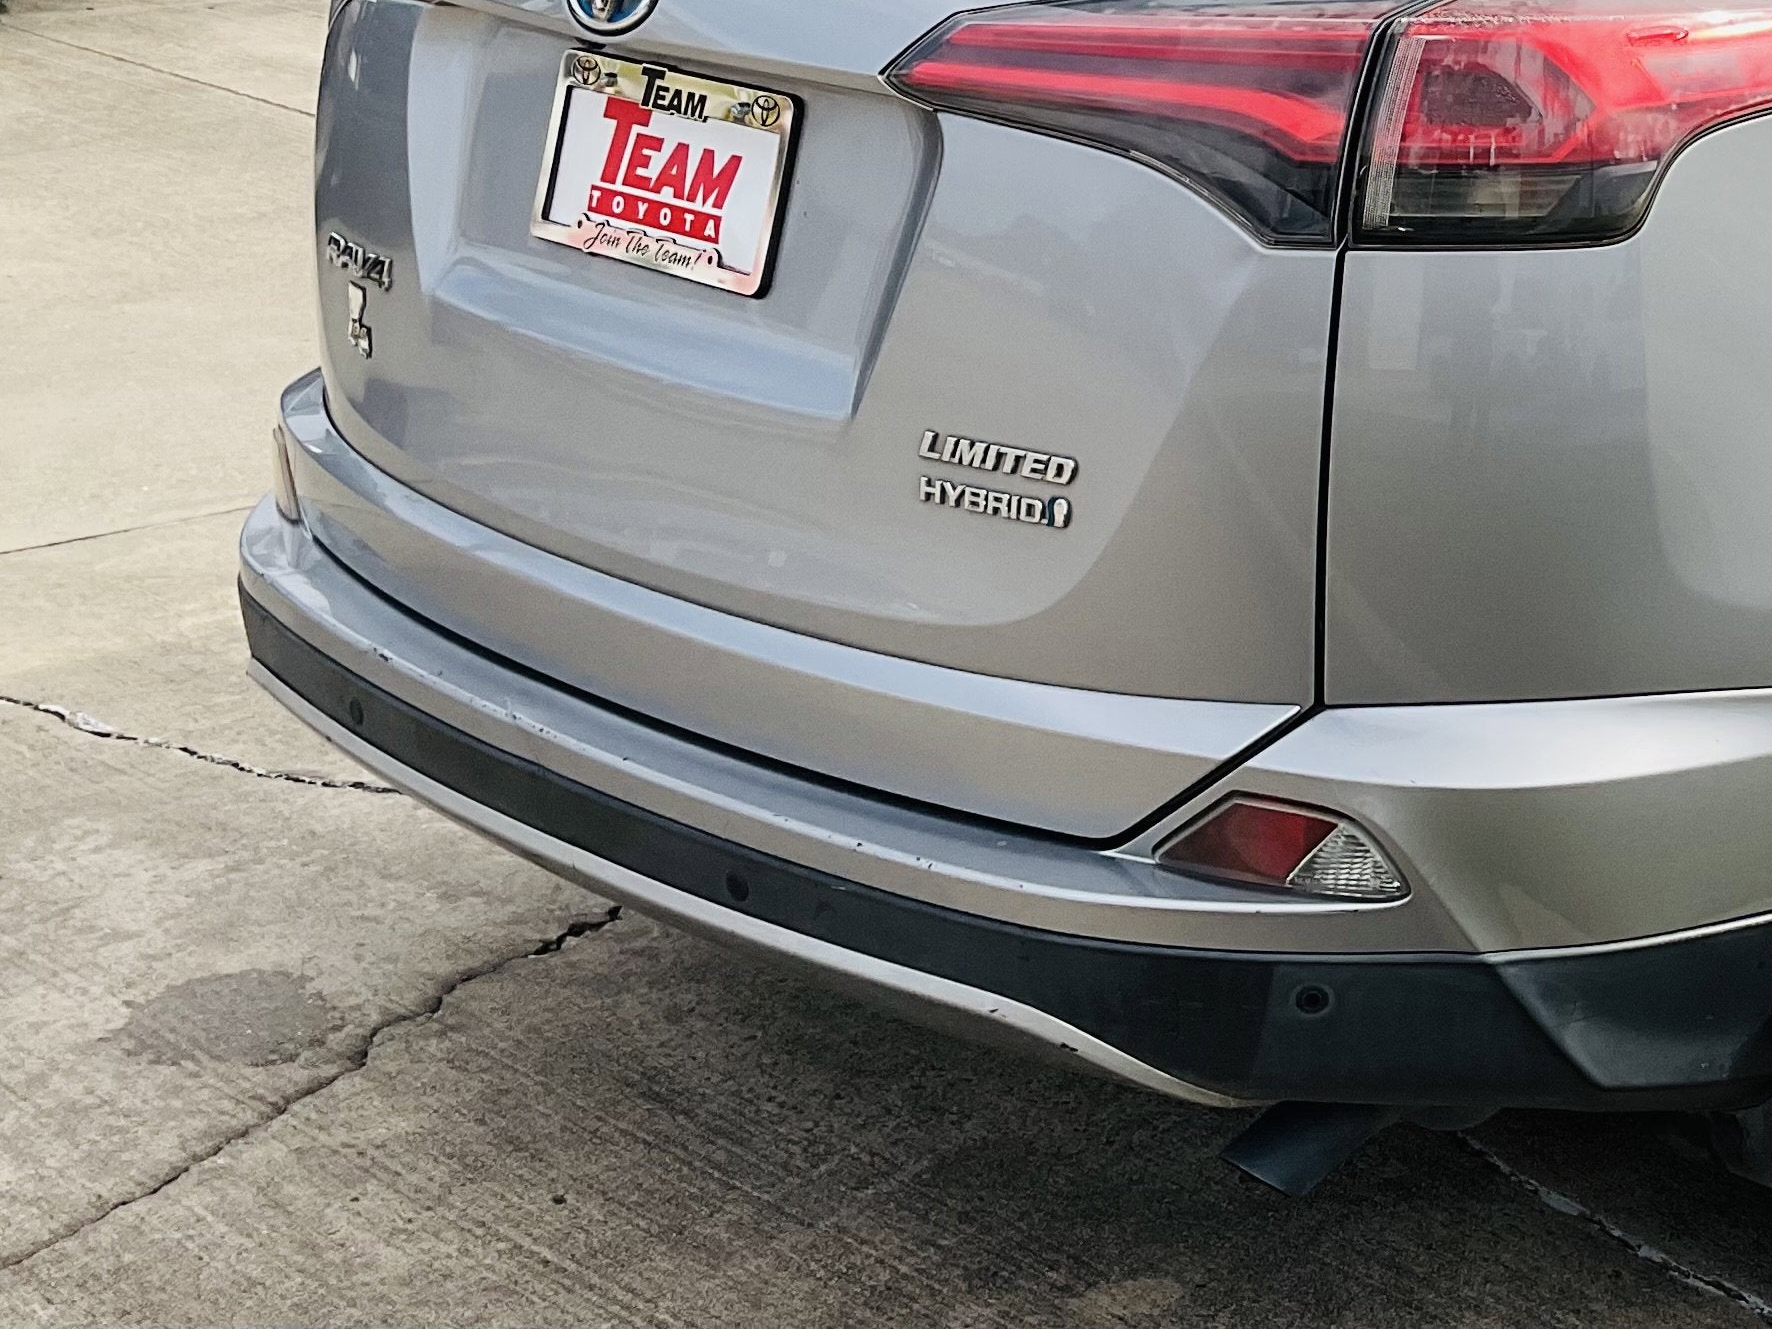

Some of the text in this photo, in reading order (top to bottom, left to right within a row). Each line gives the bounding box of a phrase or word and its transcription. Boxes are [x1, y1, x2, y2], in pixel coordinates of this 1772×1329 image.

[641, 66, 708, 120] TEAM
[600, 96, 743, 210] TEAM
[583, 221, 621, 249] Join
[625, 230, 650, 257] The
[589, 189, 716, 239] TOYOTA
[918, 429, 1078, 486] LIMITED
[919, 475, 1044, 524] HYBRID
